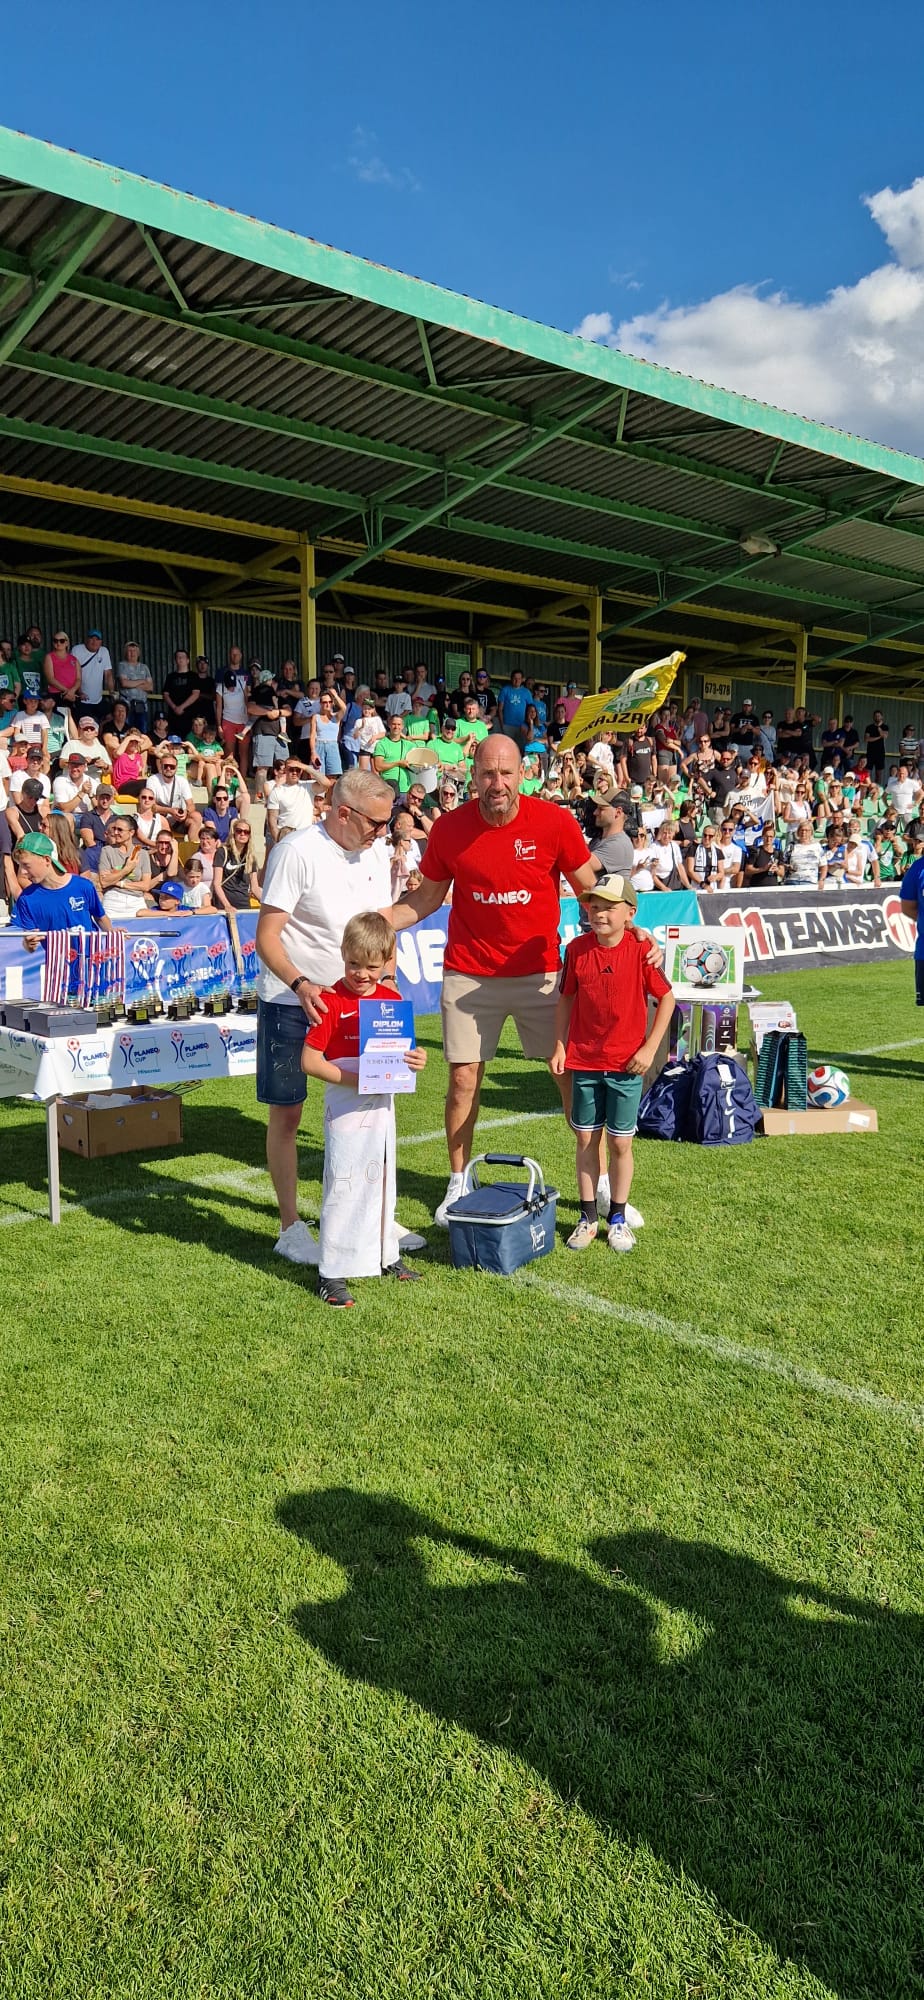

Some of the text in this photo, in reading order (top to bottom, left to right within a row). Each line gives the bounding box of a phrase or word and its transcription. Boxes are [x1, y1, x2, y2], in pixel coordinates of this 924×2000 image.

[704, 681, 731, 696] 673-978
[473, 889, 532, 905] PLANEO
[372, 1020, 404, 1028] DIPLOM
[134, 1047, 160, 1057] PLANEO
[185, 1042, 209, 1052] PLANEO
